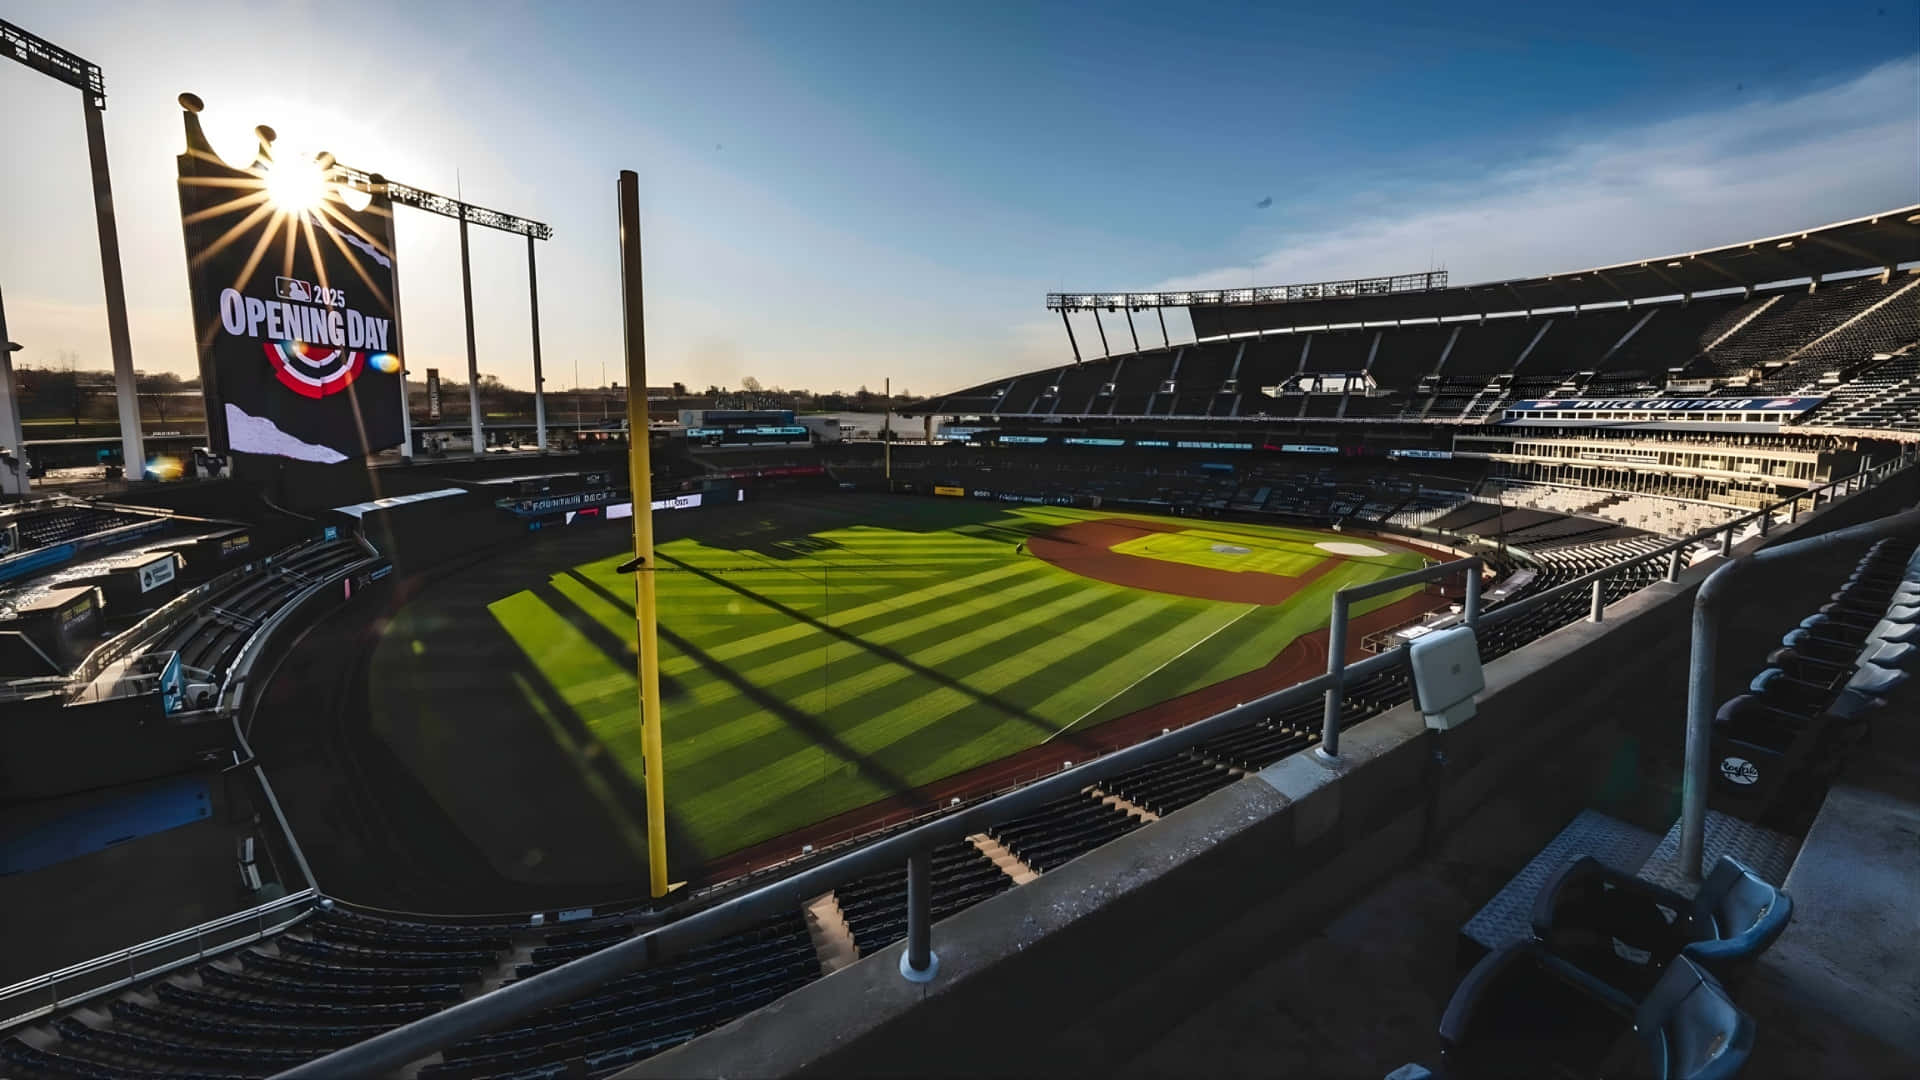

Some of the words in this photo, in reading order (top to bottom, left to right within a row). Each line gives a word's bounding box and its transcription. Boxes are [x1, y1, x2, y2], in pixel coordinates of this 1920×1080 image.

[314, 284, 345, 308] 2025
[220, 288, 345, 346] OPENING
[347, 308, 389, 351] DAY
[1574, 399, 1639, 410] PRICE
[1640, 399, 1753, 410] CHOPPER
